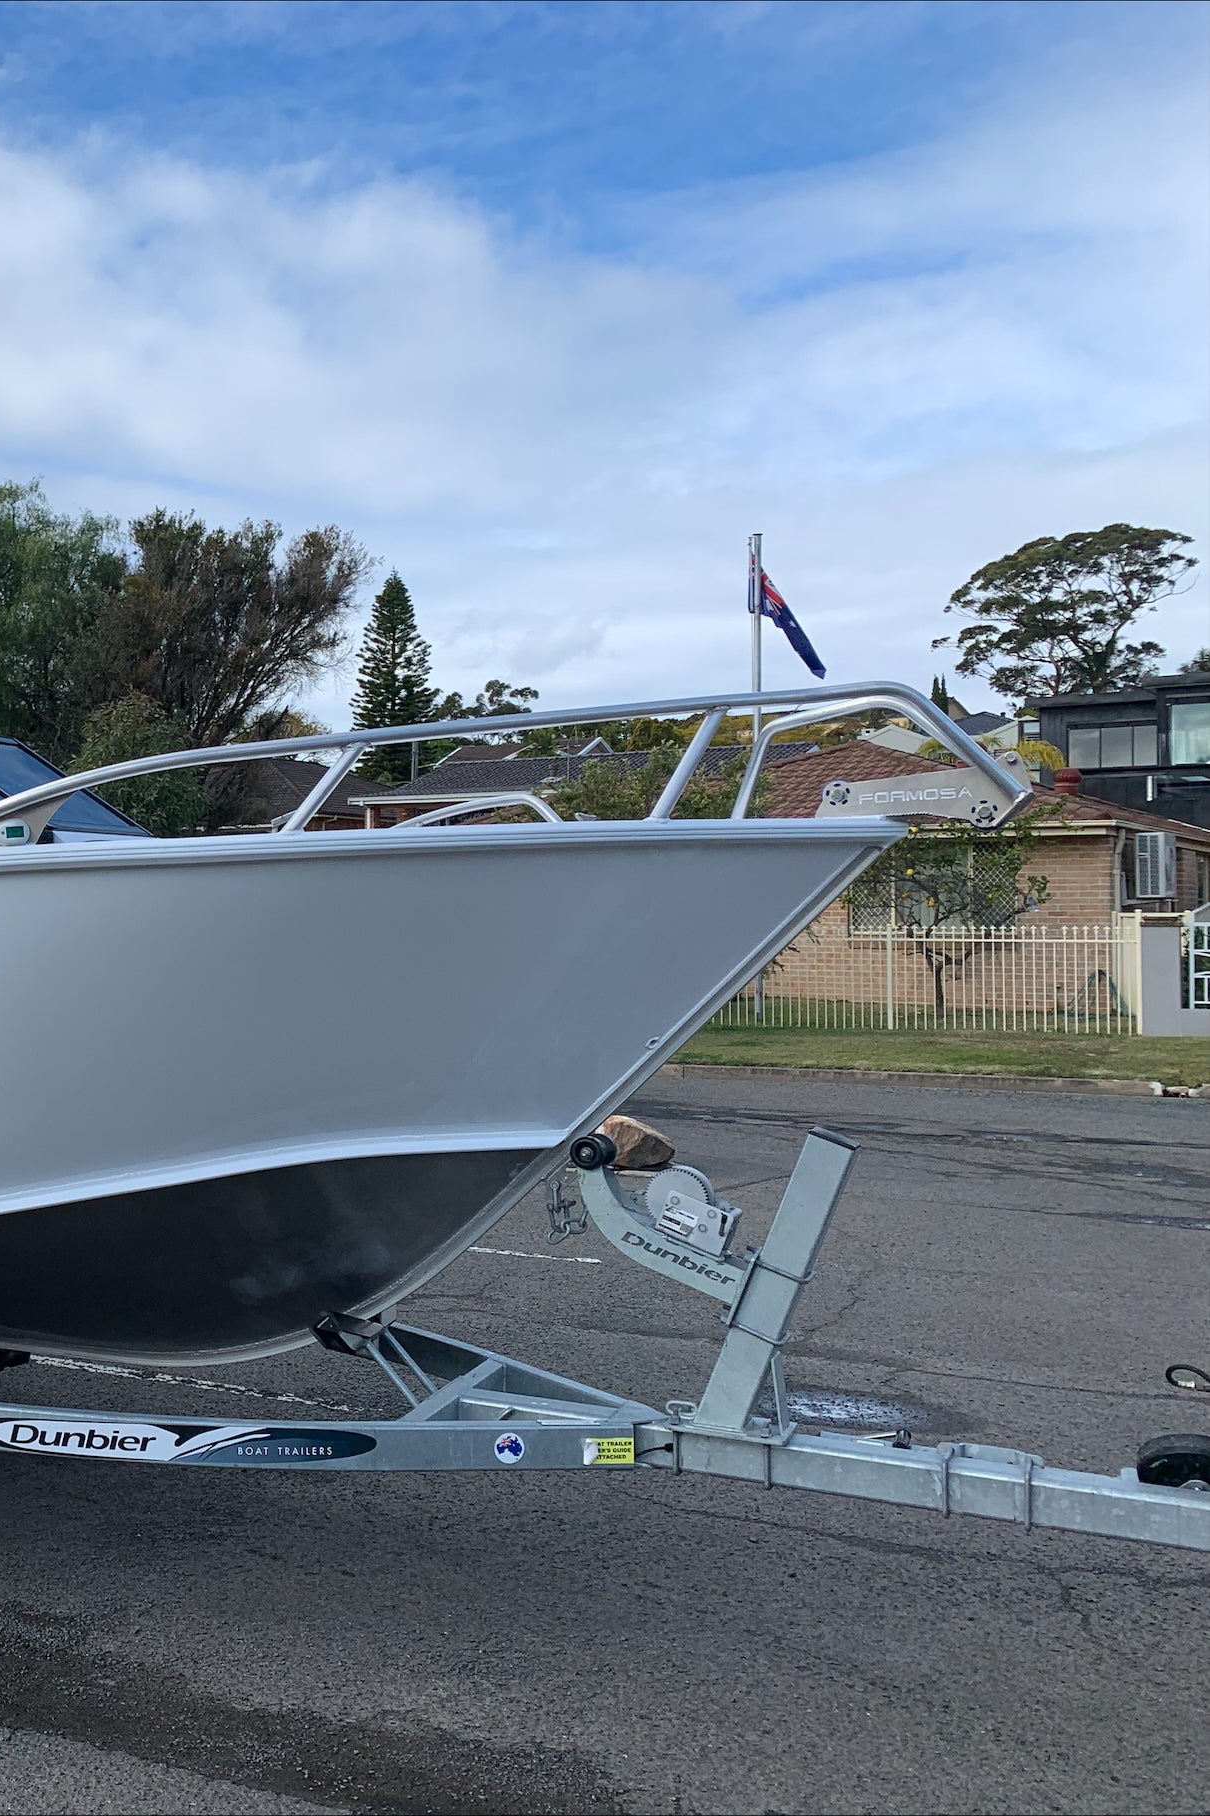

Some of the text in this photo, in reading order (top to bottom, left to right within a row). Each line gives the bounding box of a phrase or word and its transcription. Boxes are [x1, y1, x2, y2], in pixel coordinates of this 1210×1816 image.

[859, 786, 973, 805] FORMOSA
[620, 1230, 736, 1286] Dunbier
[9, 1423, 157, 1452] Dunbier
[237, 1446, 333, 1456] BOAT TRAILERS
